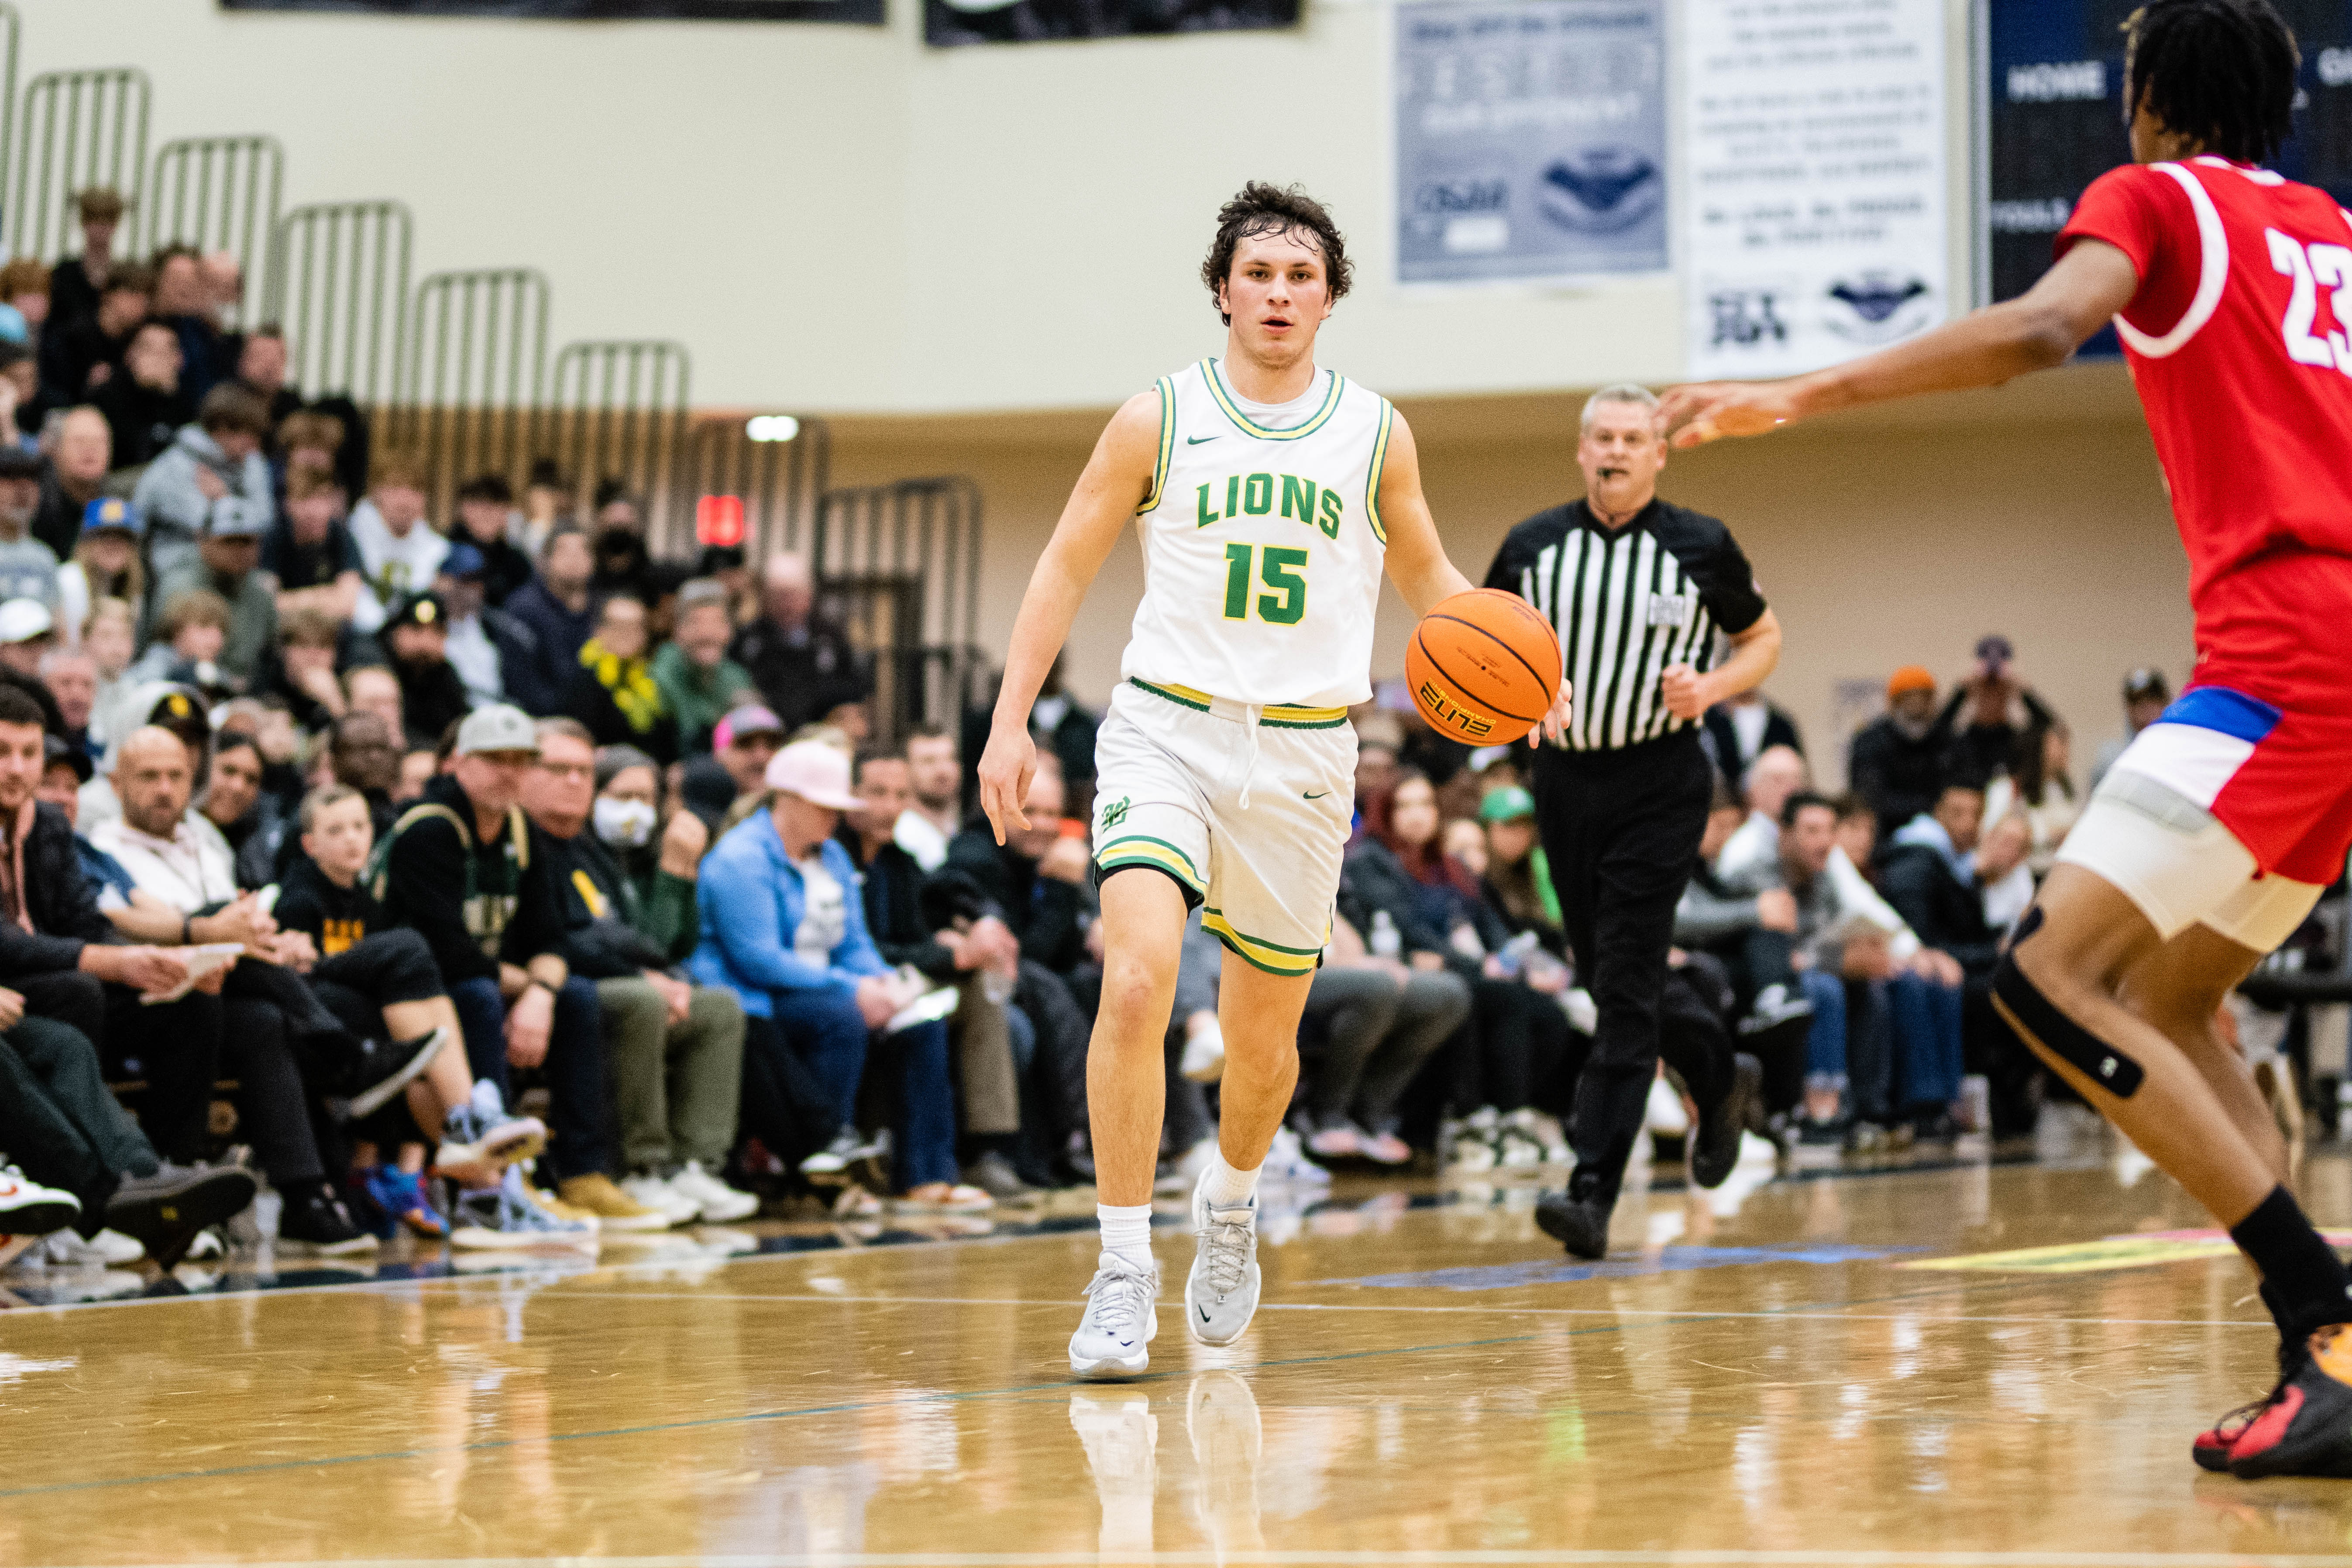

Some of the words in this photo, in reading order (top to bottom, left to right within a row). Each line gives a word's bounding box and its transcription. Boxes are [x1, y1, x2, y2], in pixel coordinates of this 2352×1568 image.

[2010, 62, 2106, 102] HOME
[2263, 226, 2352, 379] 23
[1195, 472, 1344, 540] LIONS
[1222, 541, 1310, 627] 15
[1420, 681, 1494, 737] ELITE
